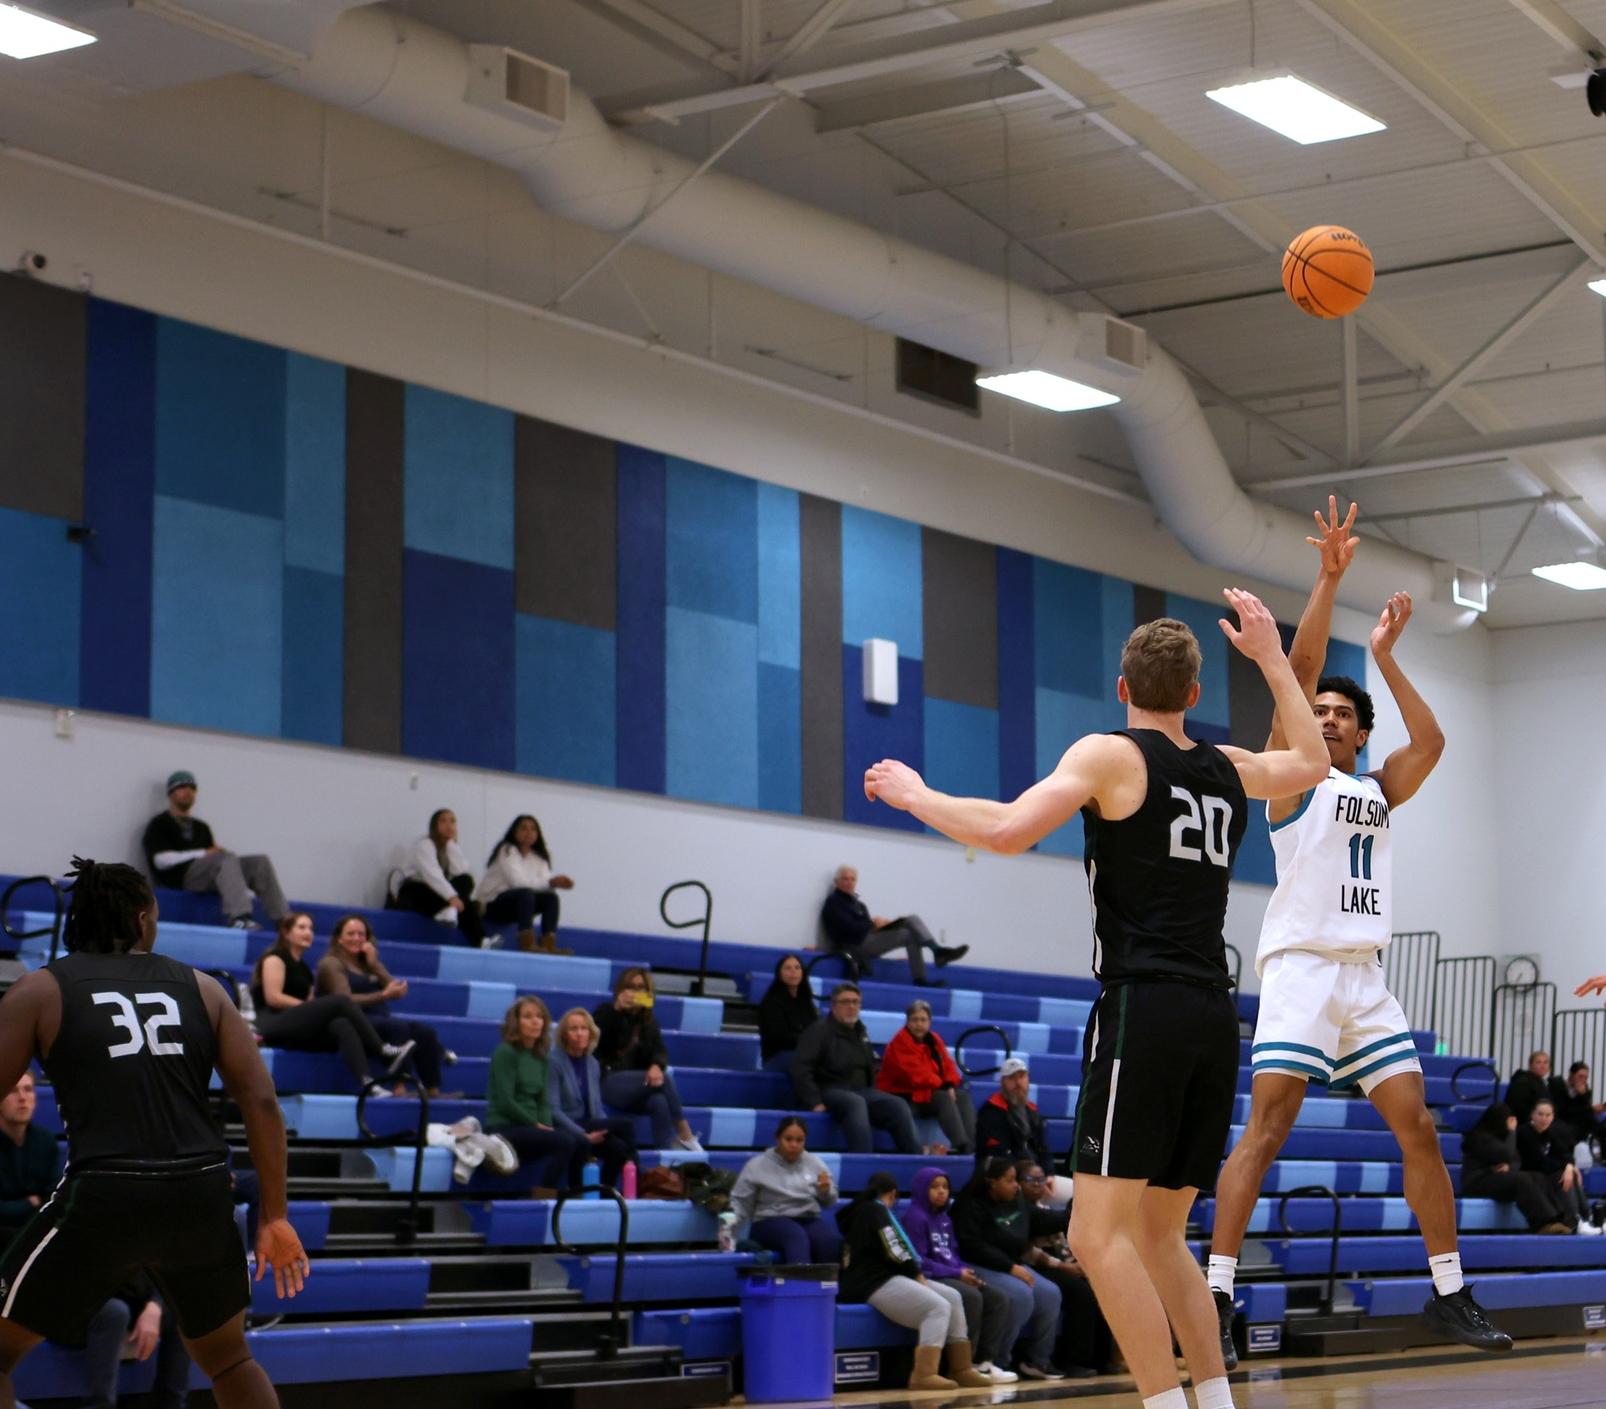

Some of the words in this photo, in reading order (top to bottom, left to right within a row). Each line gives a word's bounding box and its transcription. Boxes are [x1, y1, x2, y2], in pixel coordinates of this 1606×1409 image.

[1169, 784, 1233, 868] 20
[1335, 794, 1390, 829] FOLSOM
[1348, 832, 1375, 880] 11
[1341, 884, 1381, 916] LAKE
[91, 991, 184, 1059] 32
